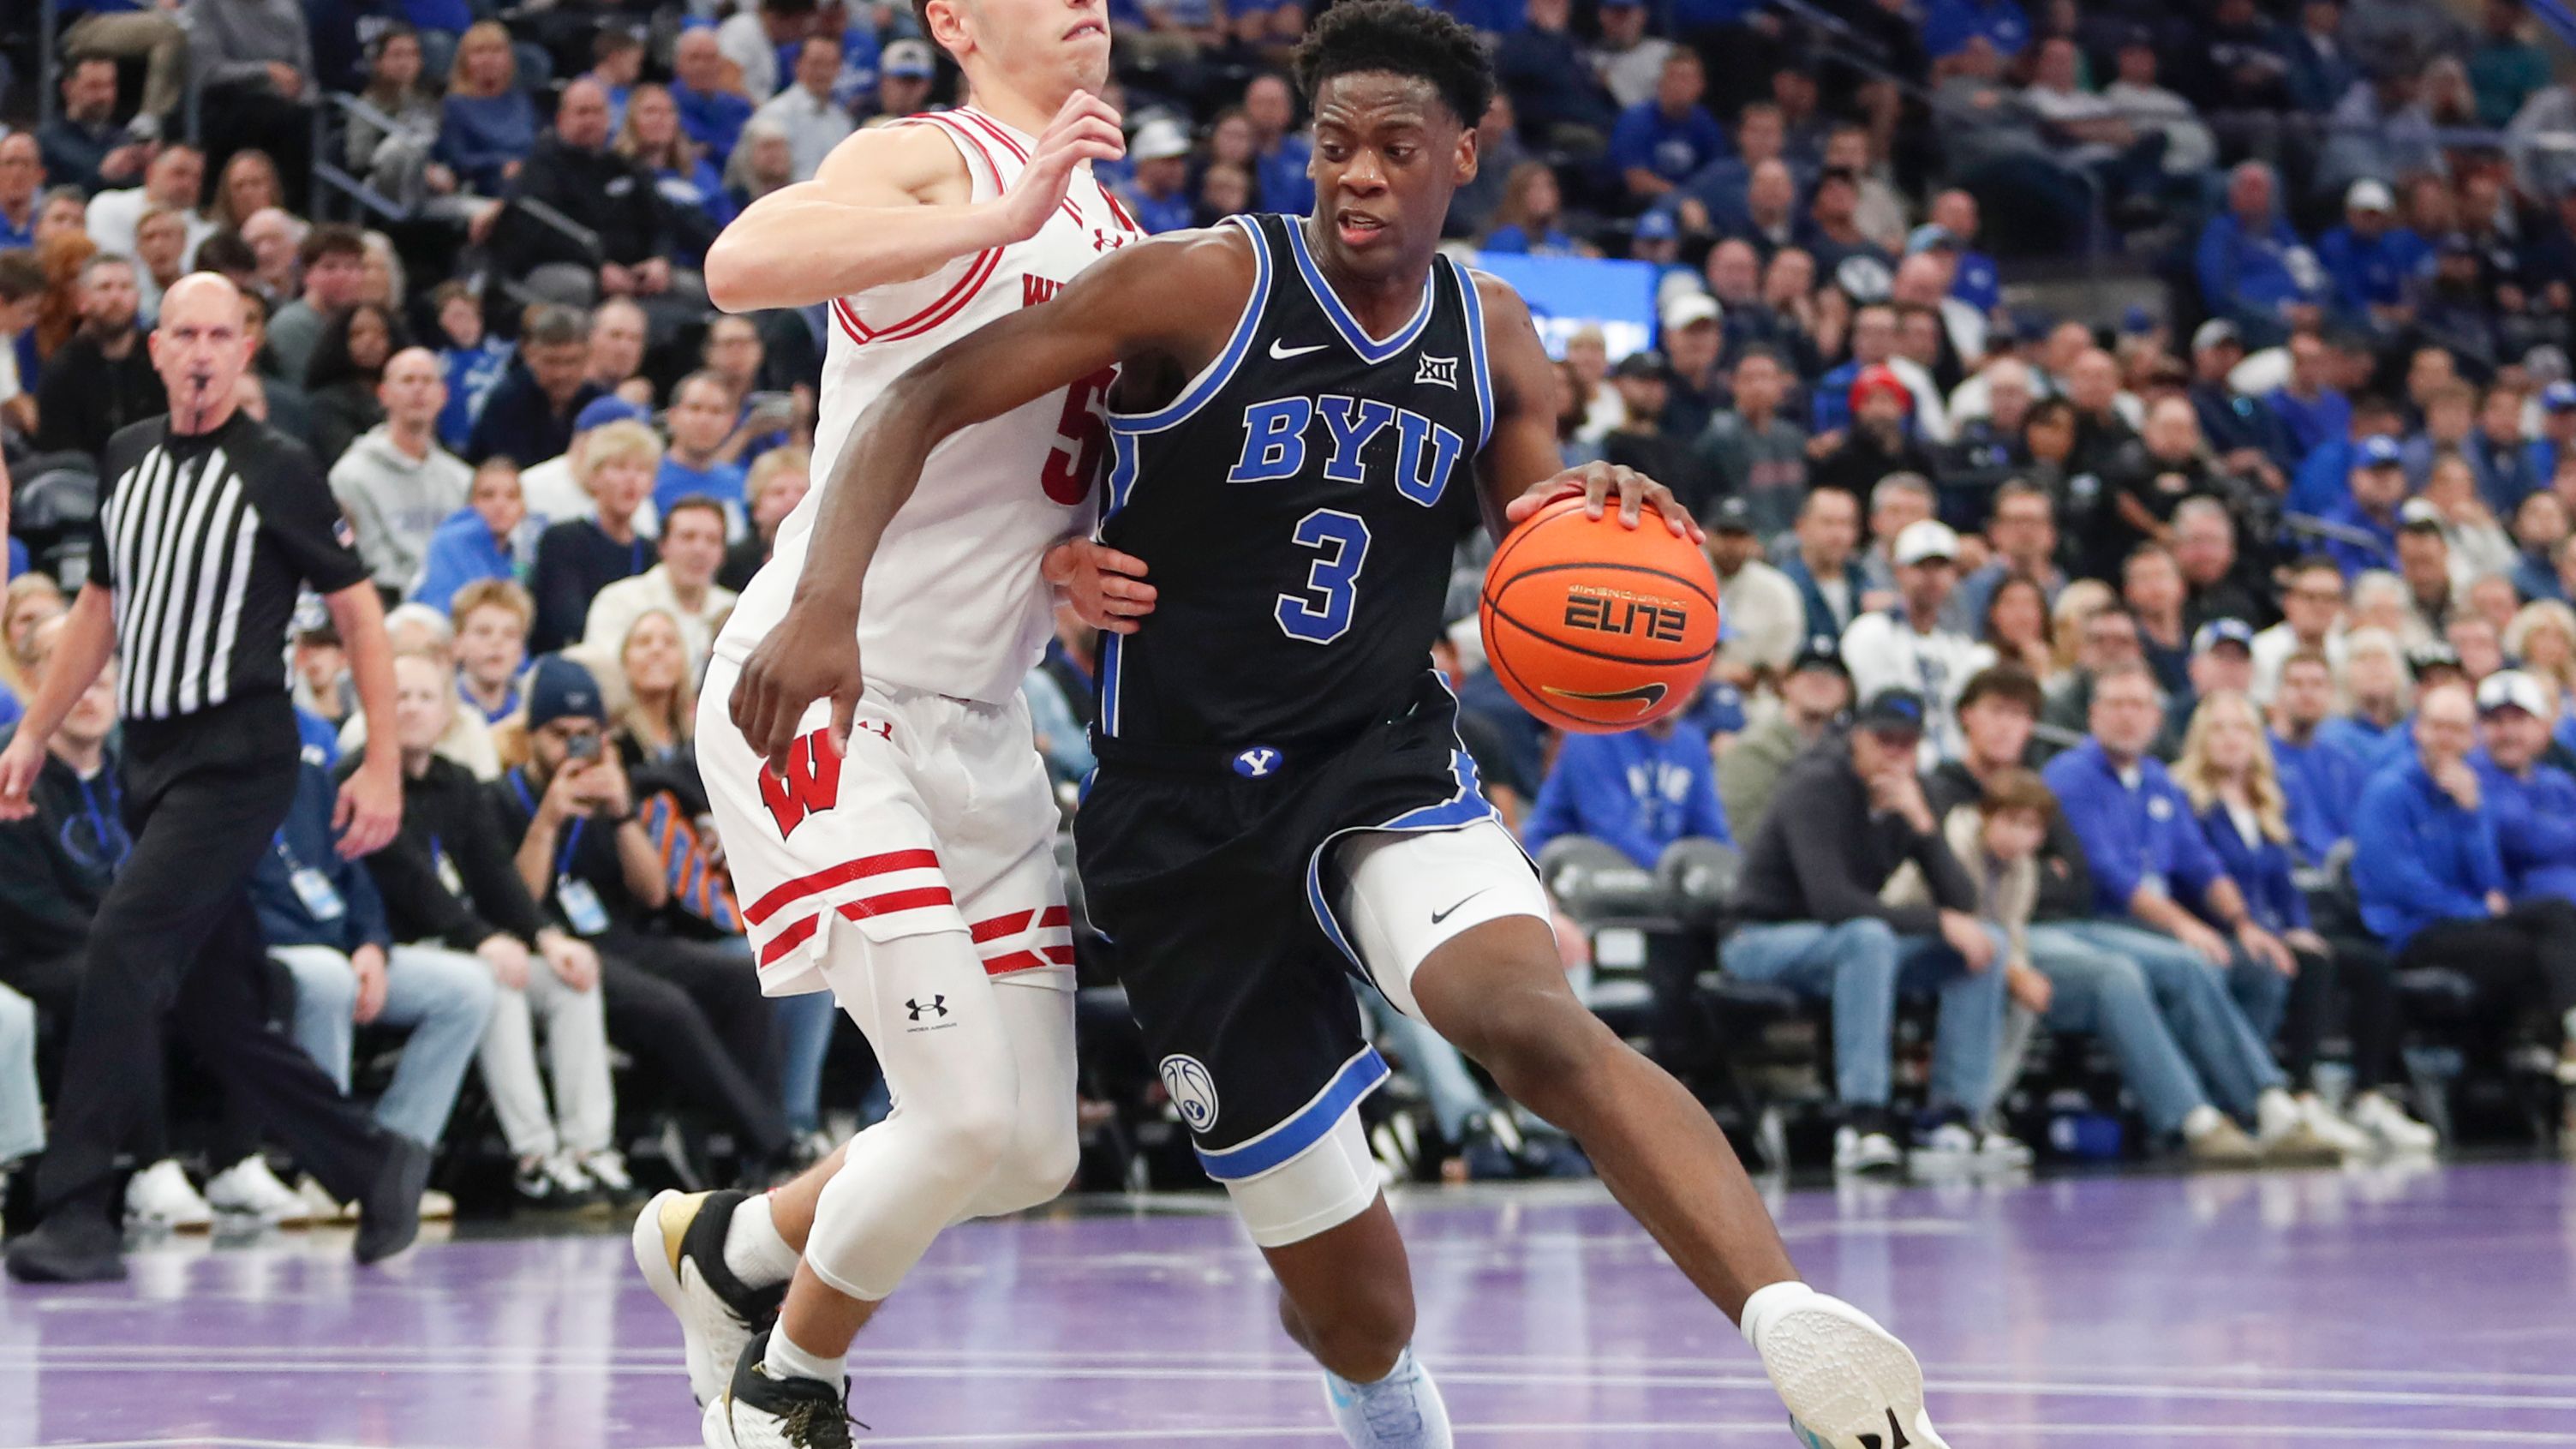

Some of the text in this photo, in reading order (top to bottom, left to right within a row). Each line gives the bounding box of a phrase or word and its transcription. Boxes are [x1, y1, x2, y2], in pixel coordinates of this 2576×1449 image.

[1041, 363, 1117, 506] 5
[1226, 394, 1463, 507] BYU
[1274, 507, 1372, 645] 3
[1564, 594, 1687, 643] ELITE
[758, 727, 842, 843] W
[1240, 749, 1274, 775] Y
